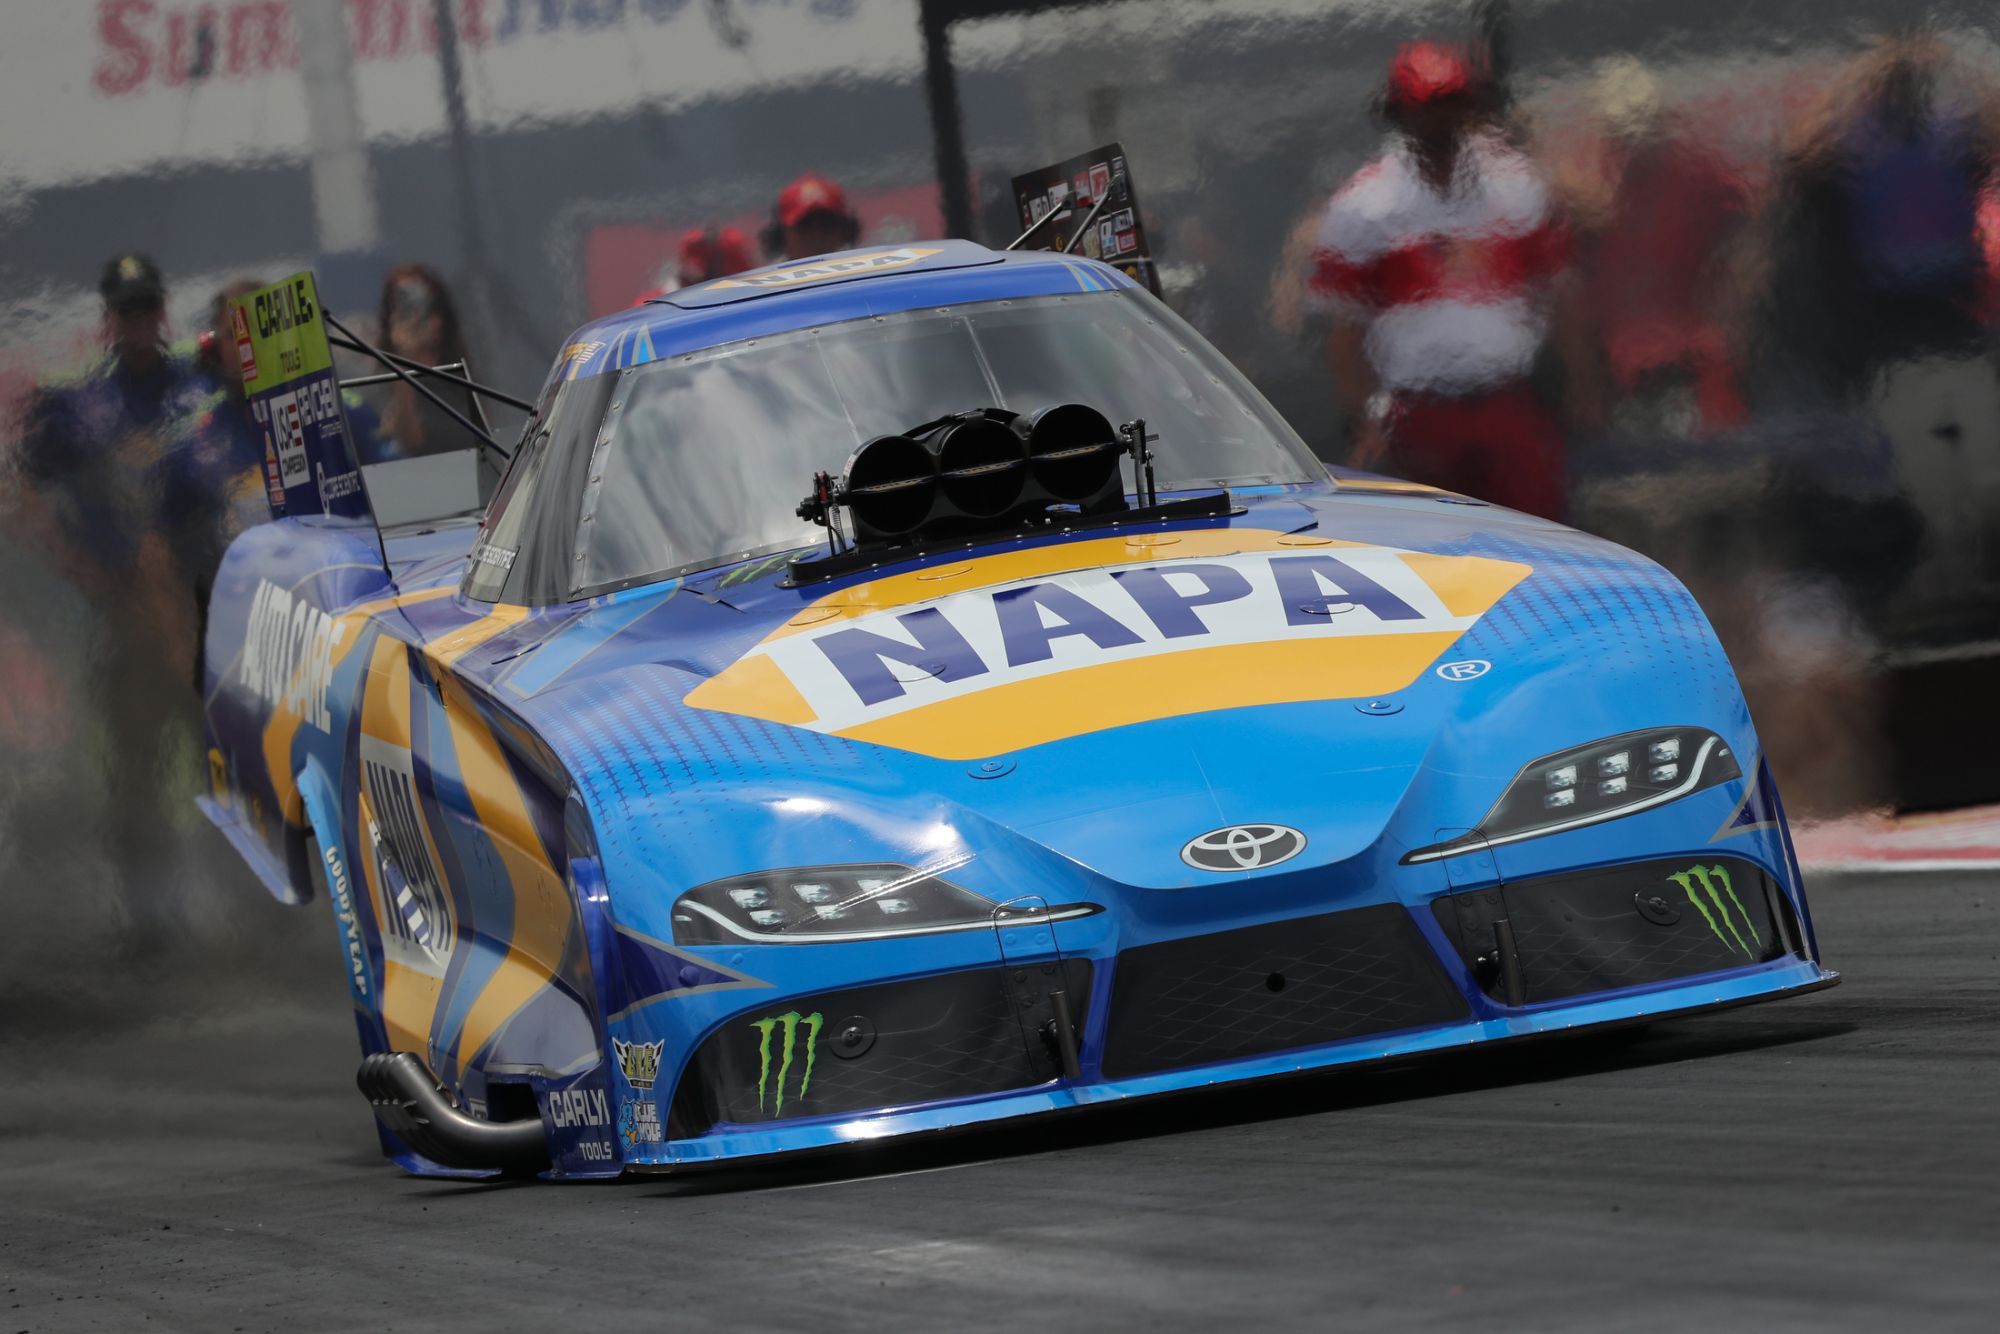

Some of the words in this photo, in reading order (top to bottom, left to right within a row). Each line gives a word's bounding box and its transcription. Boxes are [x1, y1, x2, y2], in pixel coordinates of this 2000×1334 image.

[743, 255, 913, 286] NAPA
[287, 599, 345, 735] CARE
[812, 555, 1426, 706] NAPA
[579, 1141, 612, 1160] TOOLS
